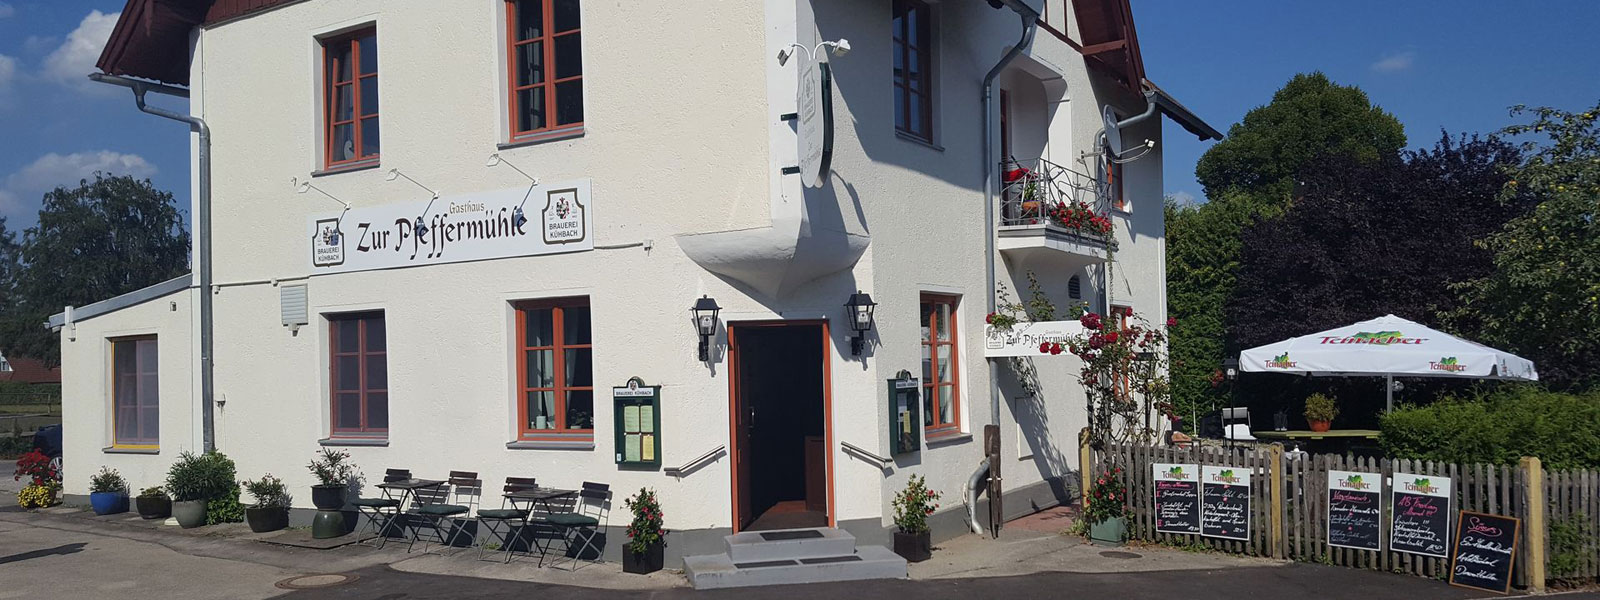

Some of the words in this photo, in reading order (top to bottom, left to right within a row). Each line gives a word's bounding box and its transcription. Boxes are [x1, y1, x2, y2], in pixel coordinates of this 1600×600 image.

[449, 199, 485, 215] Gasthaus
[549, 221, 578, 230] BRAUEREI
[356, 222, 390, 252] Zur
[394, 205, 528, 261] Pfeffermühle
[549, 229, 578, 239] KÜHBACH
[317, 246, 340, 255] BRAUEREI
[1006, 334, 1021, 347] Zur
[1320, 335, 1430, 346] Teinacher
[1264, 359, 1298, 369] Teinacher
[1429, 361, 1467, 372] Teinacher
[1337, 478, 1371, 490] Teinacher
[1403, 481, 1440, 494] Teinacher
